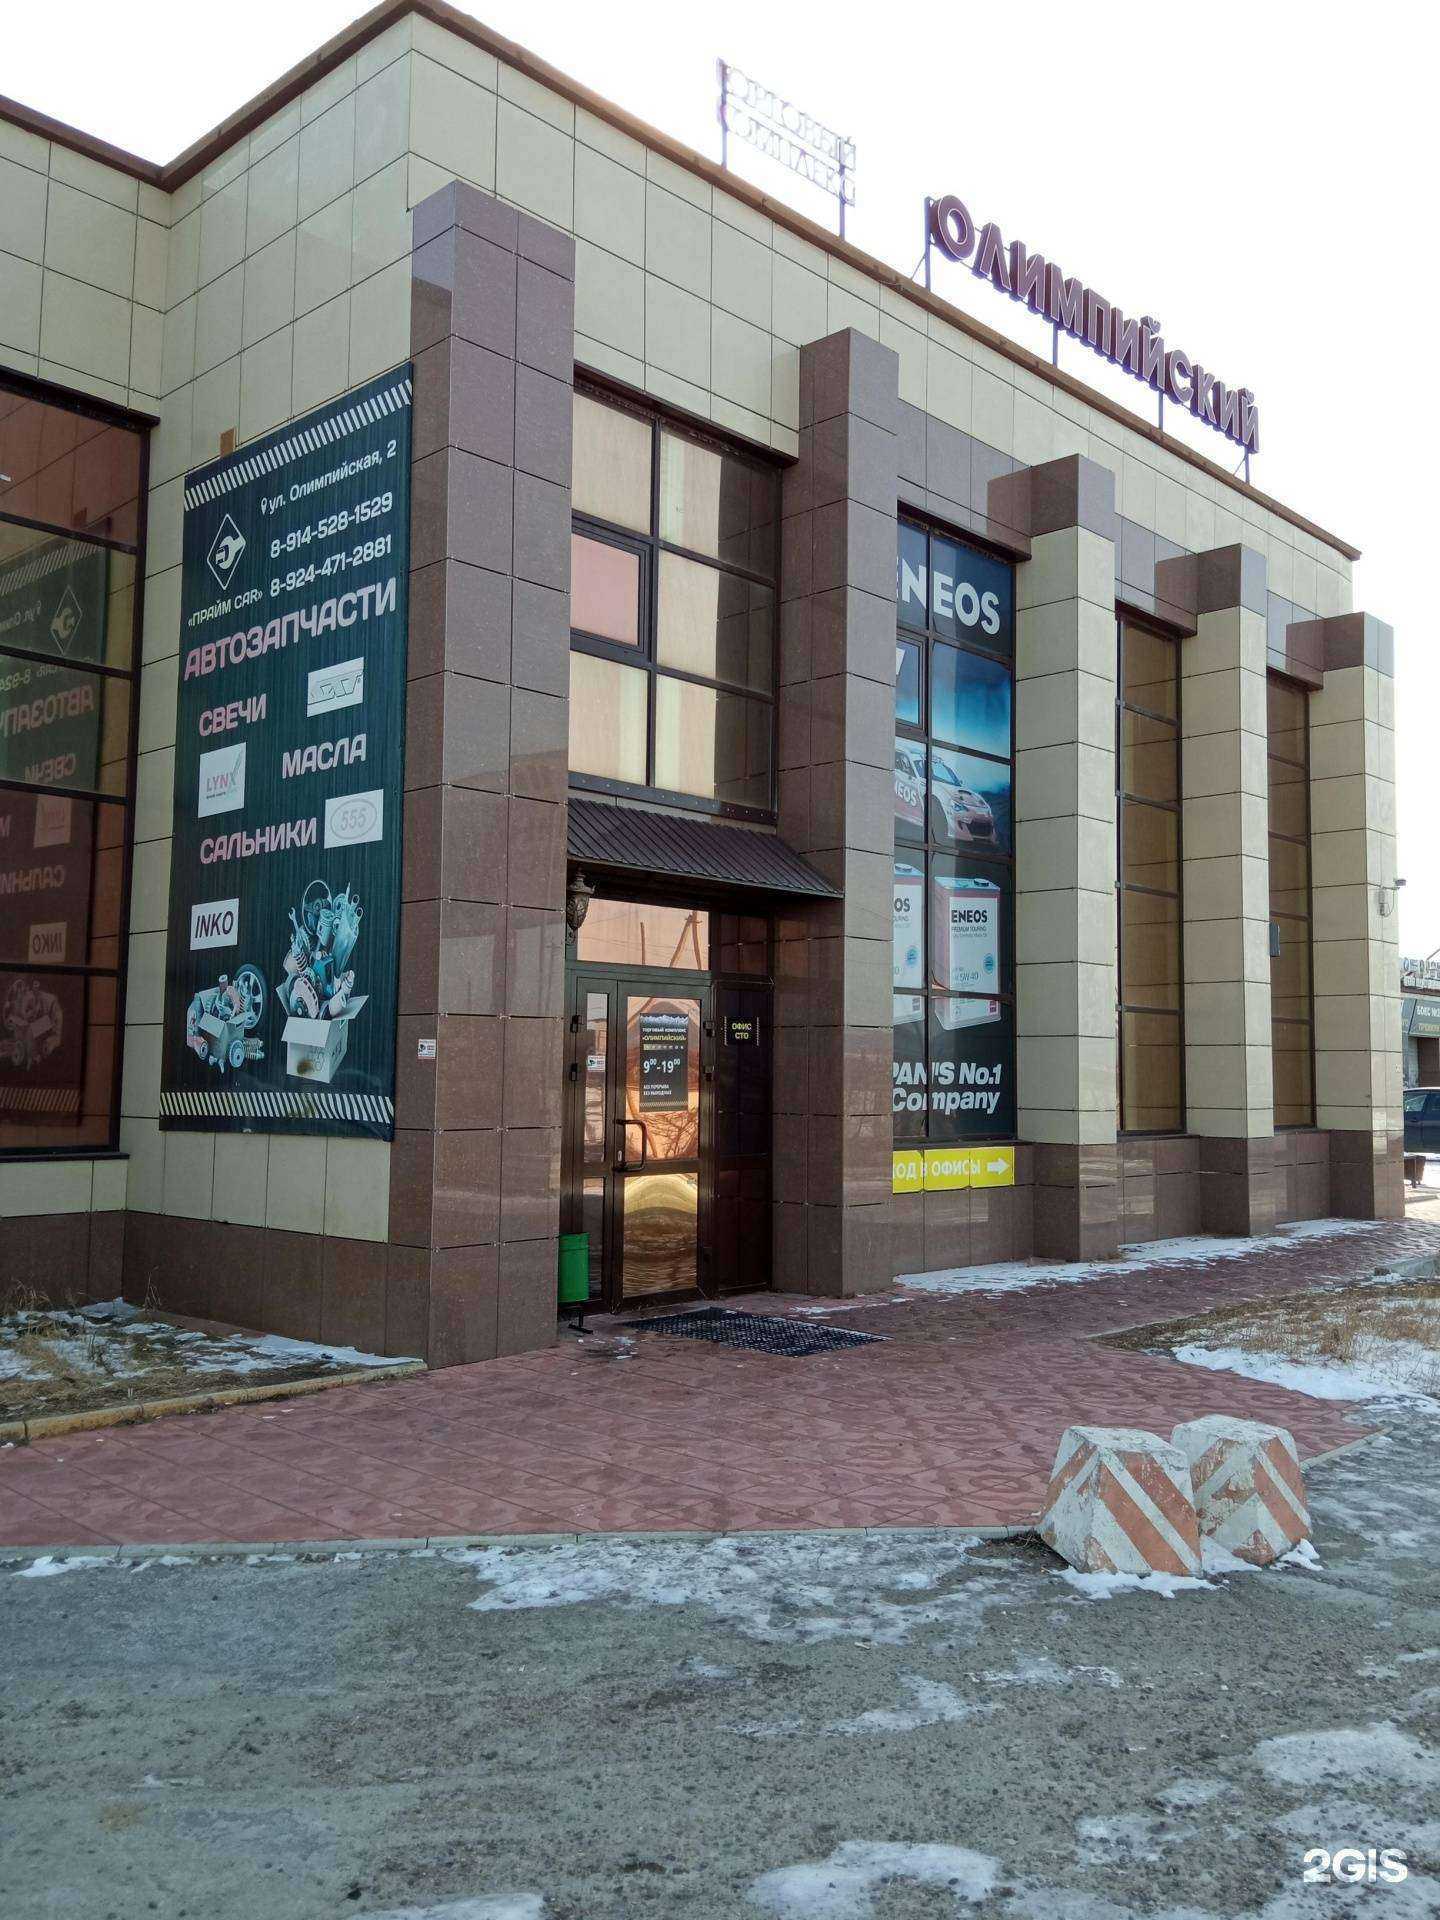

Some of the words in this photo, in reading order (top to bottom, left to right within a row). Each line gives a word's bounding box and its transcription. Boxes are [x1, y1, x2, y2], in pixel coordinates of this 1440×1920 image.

[929, 194, 1261, 454] ОЛИМПИЙСКИЙ
[269, 496, 286, 515] ул.
[289, 452, 383, 502] Олимпийская,
[387, 439, 397, 458] 2
[270, 491, 393, 559] 8-914-528-1529
[269, 534, 393, 598] 8-924-471-2881
[188, 600, 232, 627] «ПРАЙМ
[896, 556, 1000, 635] NEOS
[184, 576, 397, 682] АВТОЗАПЧАСТИ
[199, 693, 267, 737] СВЕЧИ
[282, 733, 367, 780] МАСЛА
[340, 806, 368, 832] 555
[200, 817, 317, 865] САЛЬНИКИ
[194, 910, 235, 939] INKO
[951, 909, 988, 924] ENEOS
[731, 1022, 752, 1031] ОФИС
[735, 1032, 749, 1040] СТО
[958, 1062, 1002, 1085] No.1
[892, 1087, 1001, 1116] Company
[893, 1161, 917, 1181] ОД
[931, 1158, 981, 1177] ОФИСЫ
